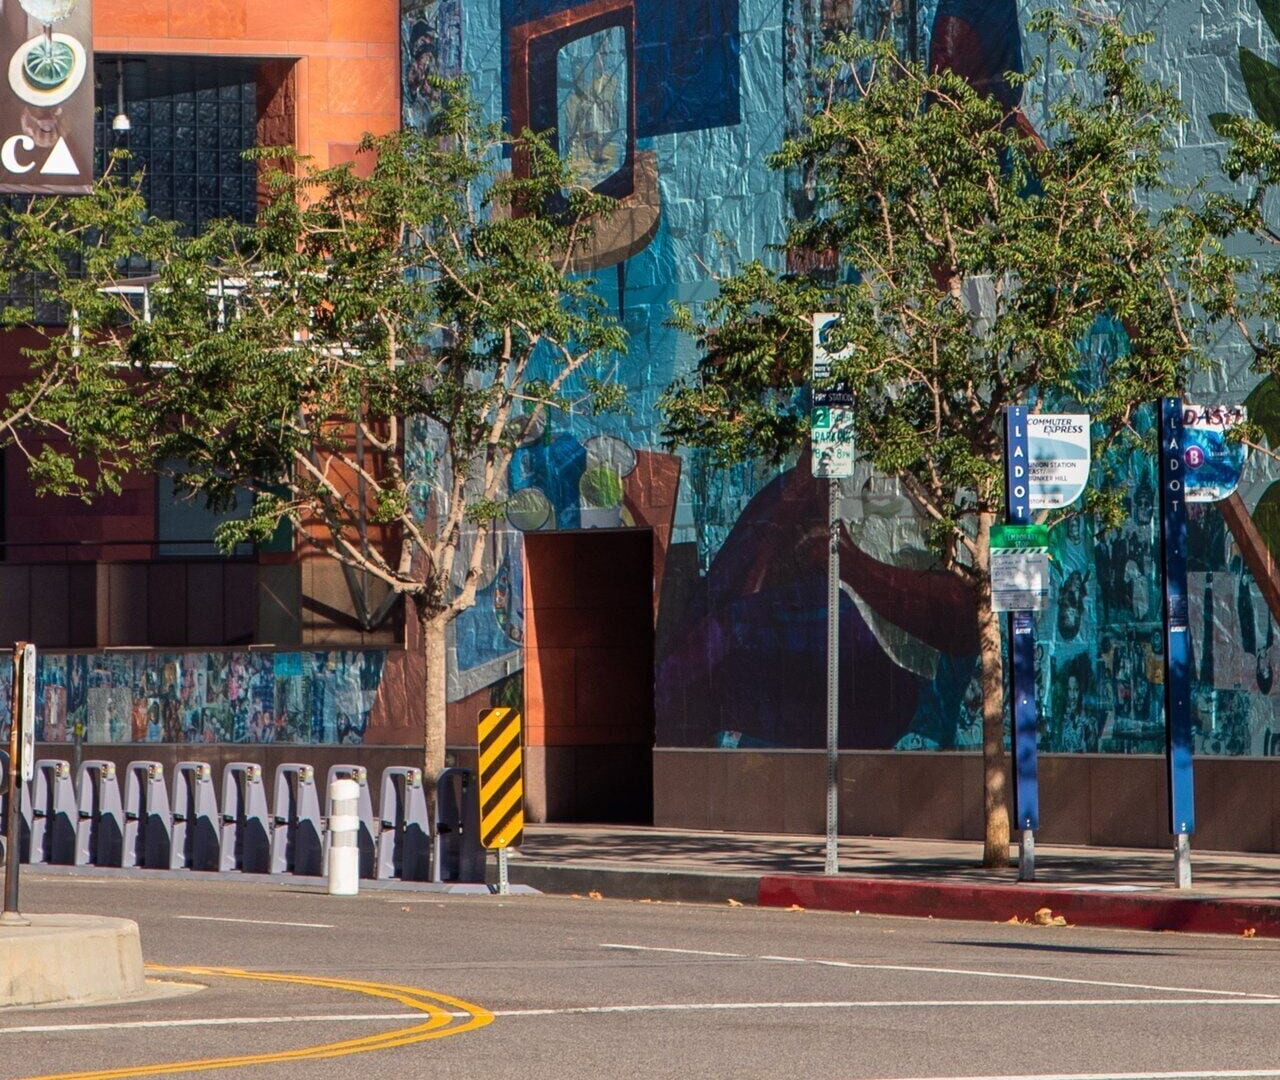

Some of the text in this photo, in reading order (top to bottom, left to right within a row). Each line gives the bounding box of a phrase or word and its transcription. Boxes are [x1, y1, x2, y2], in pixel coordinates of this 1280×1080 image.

[1027, 418, 1072, 426] COMMUTER
[1043, 425, 1084, 434] EXPRESS
[1190, 451, 1199, 465] B
